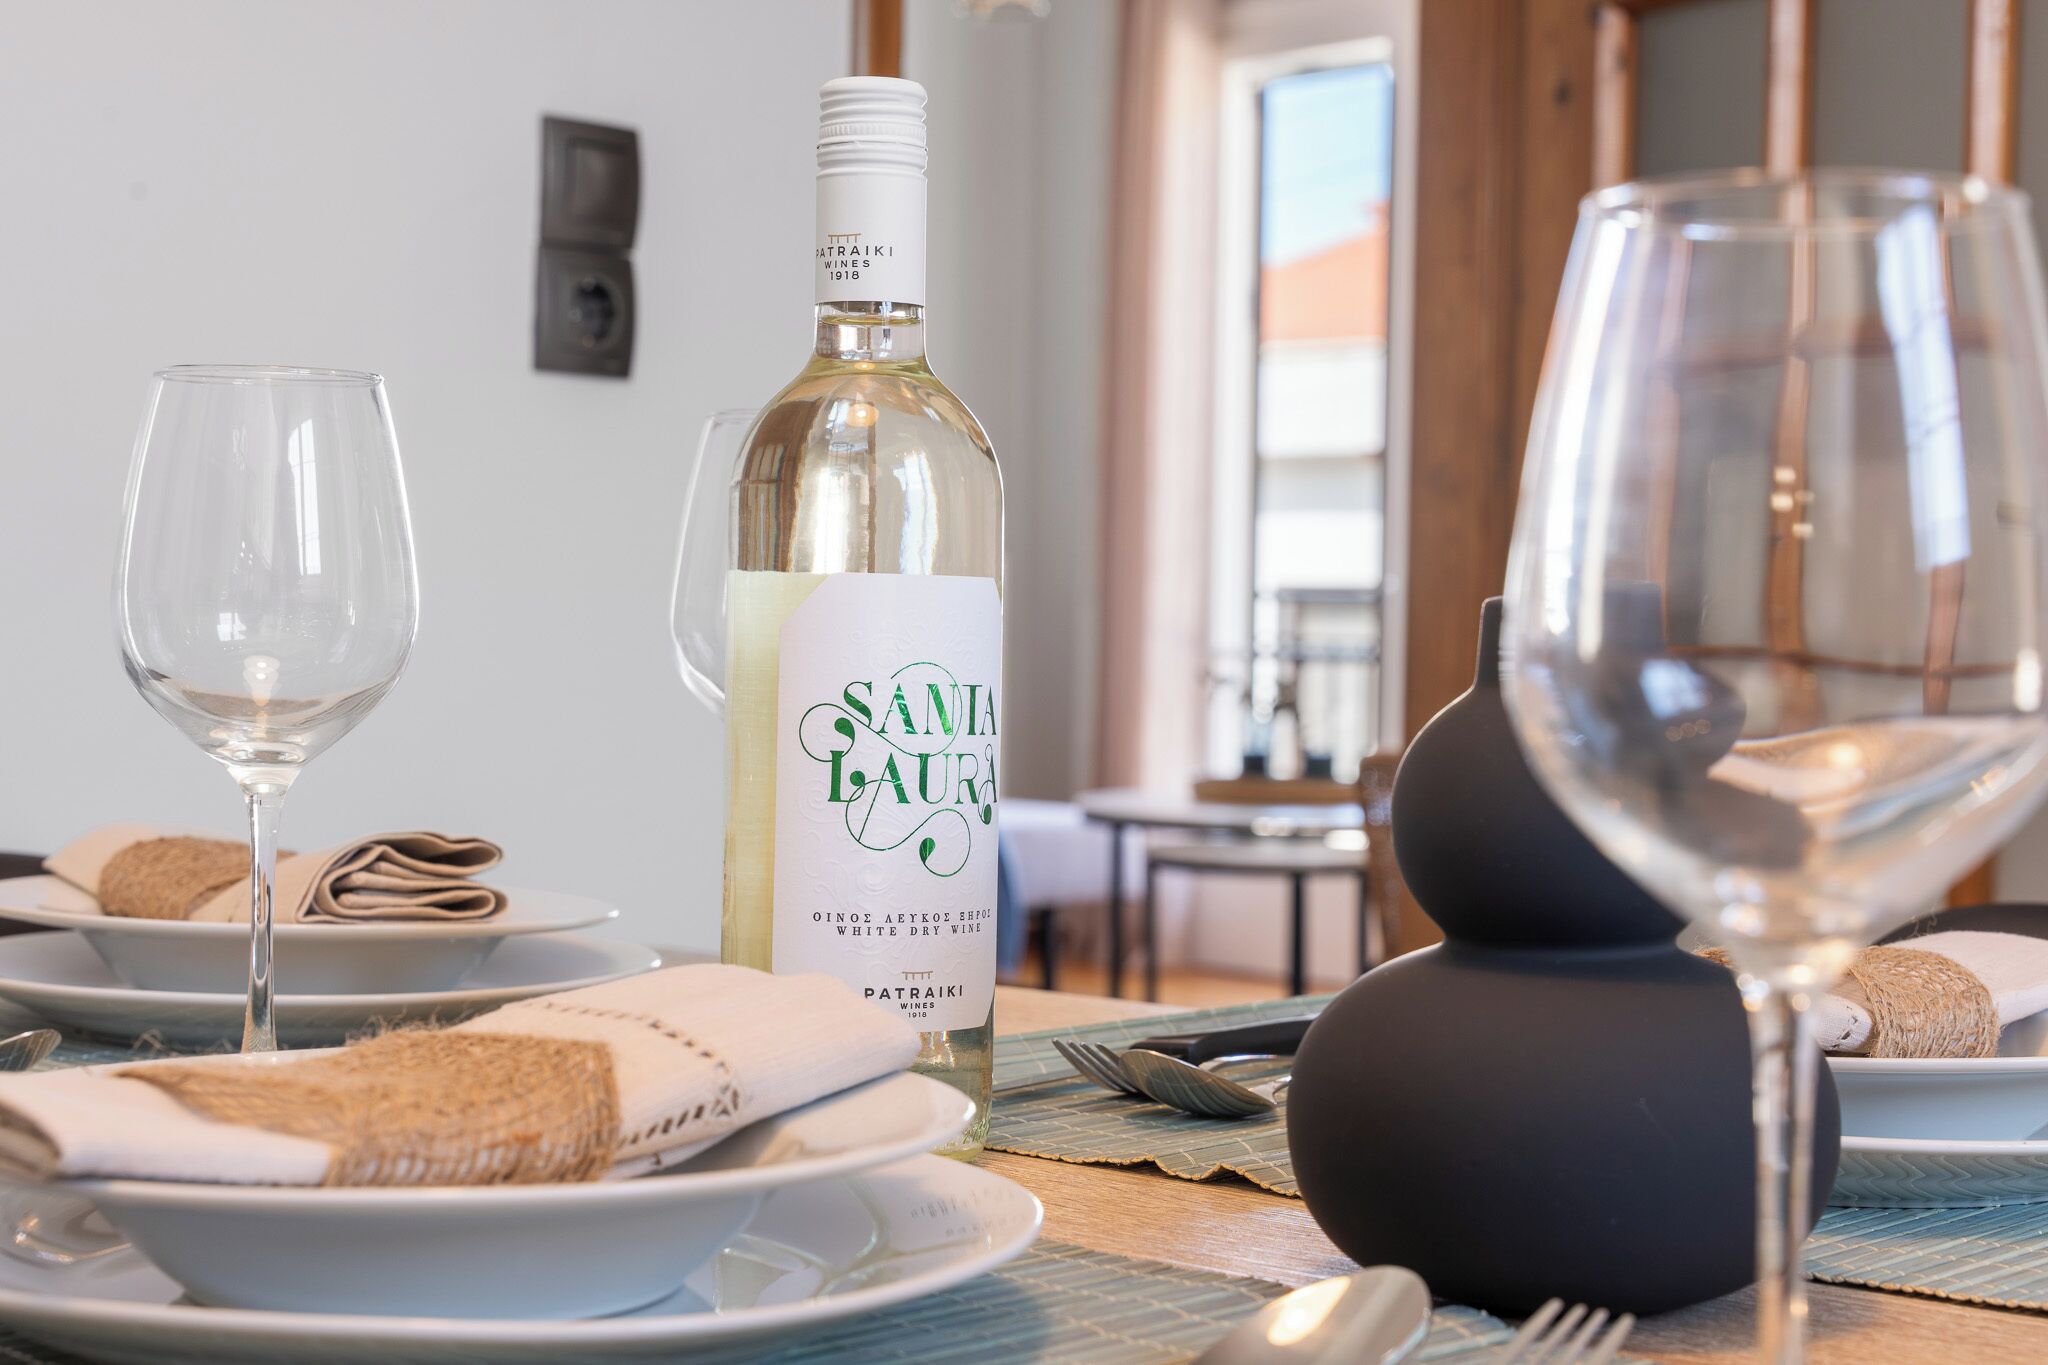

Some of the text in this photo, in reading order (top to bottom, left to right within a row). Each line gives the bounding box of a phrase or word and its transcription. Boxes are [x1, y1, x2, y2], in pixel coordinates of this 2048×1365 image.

[824, 259, 870, 269] WINES
[830, 270, 860, 281] 1918
[827, 743, 998, 842] LAURA
[812, 911, 872, 923] ΟΙΝΟΣ
[885, 912, 950, 923] ΛΕΥΚΟΣ
[837, 923, 981, 936] WHITE DRY WINE
[864, 984, 963, 1000] PATRAIKI
[900, 1001, 935, 1010] WINES
[908, 1011, 927, 1019] 1918
